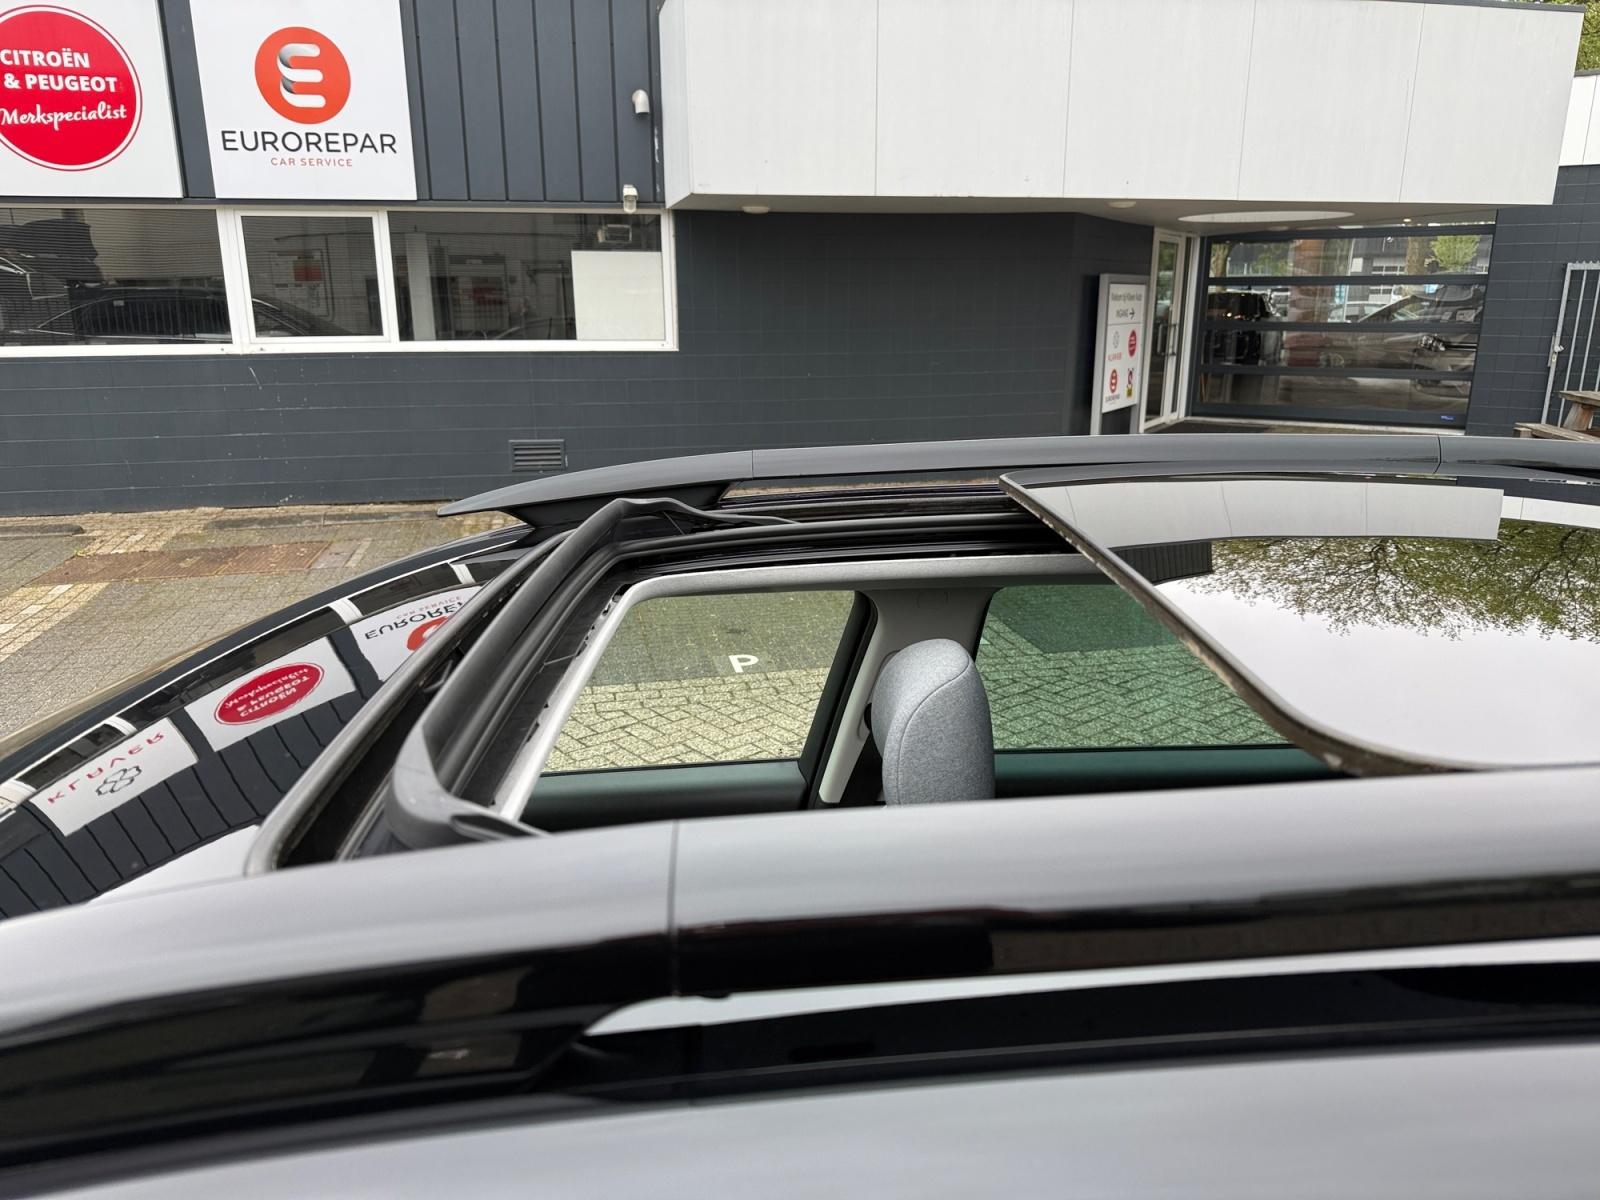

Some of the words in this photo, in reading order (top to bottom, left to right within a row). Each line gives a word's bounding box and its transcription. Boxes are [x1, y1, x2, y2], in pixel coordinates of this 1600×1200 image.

[0, 47, 91, 68] CITROËN
[3, 72, 21, 89] &
[24, 73, 118, 93] PEUGEOT
[0, 101, 127, 131] Merkspecialist
[221, 130, 397, 154] EUROREPAR
[270, 157, 296, 167] CAR
[300, 157, 353, 167] SERVICE
[728, 654, 759, 673] P
